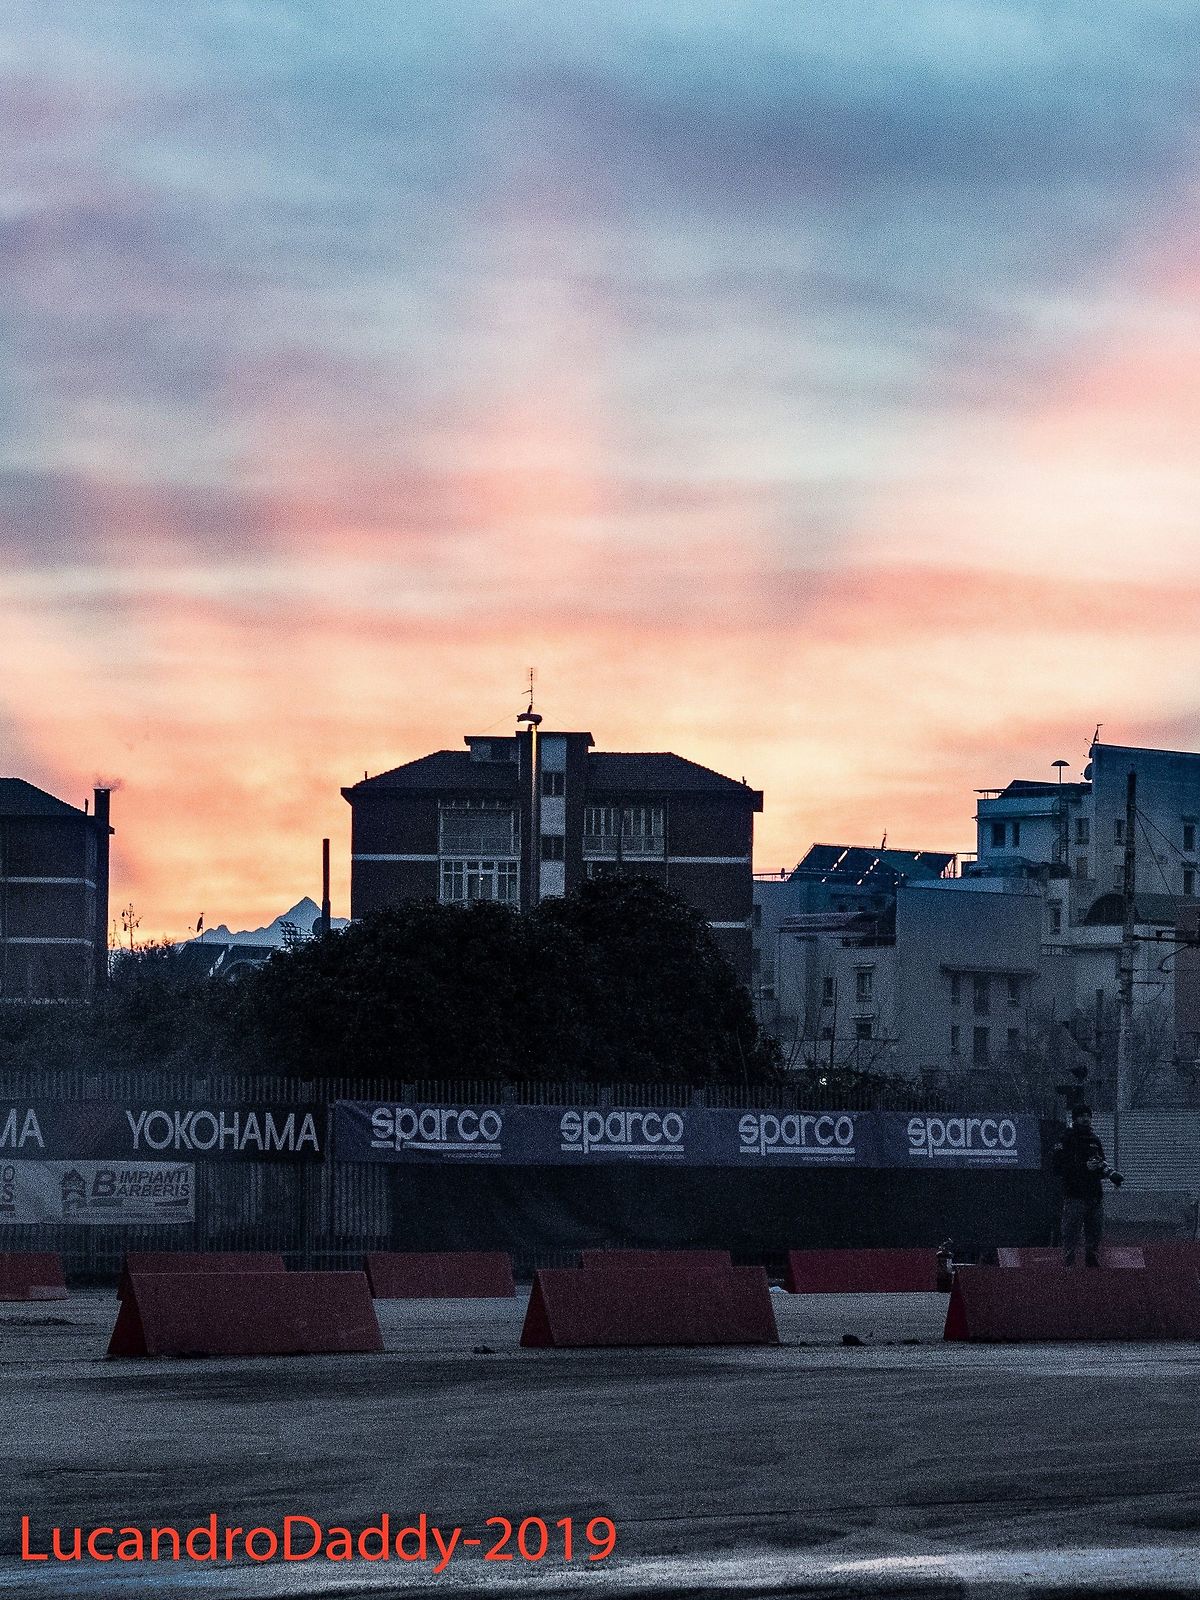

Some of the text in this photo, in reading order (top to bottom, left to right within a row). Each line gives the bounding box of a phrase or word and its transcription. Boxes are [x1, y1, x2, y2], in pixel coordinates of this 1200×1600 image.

[125, 1110, 320, 1152] YOKOHAMA
[371, 1107, 503, 1152] sparco
[560, 1111, 684, 1154] sparco
[738, 1114, 854, 1157] sparco
[907, 1117, 1017, 1159] sparco
